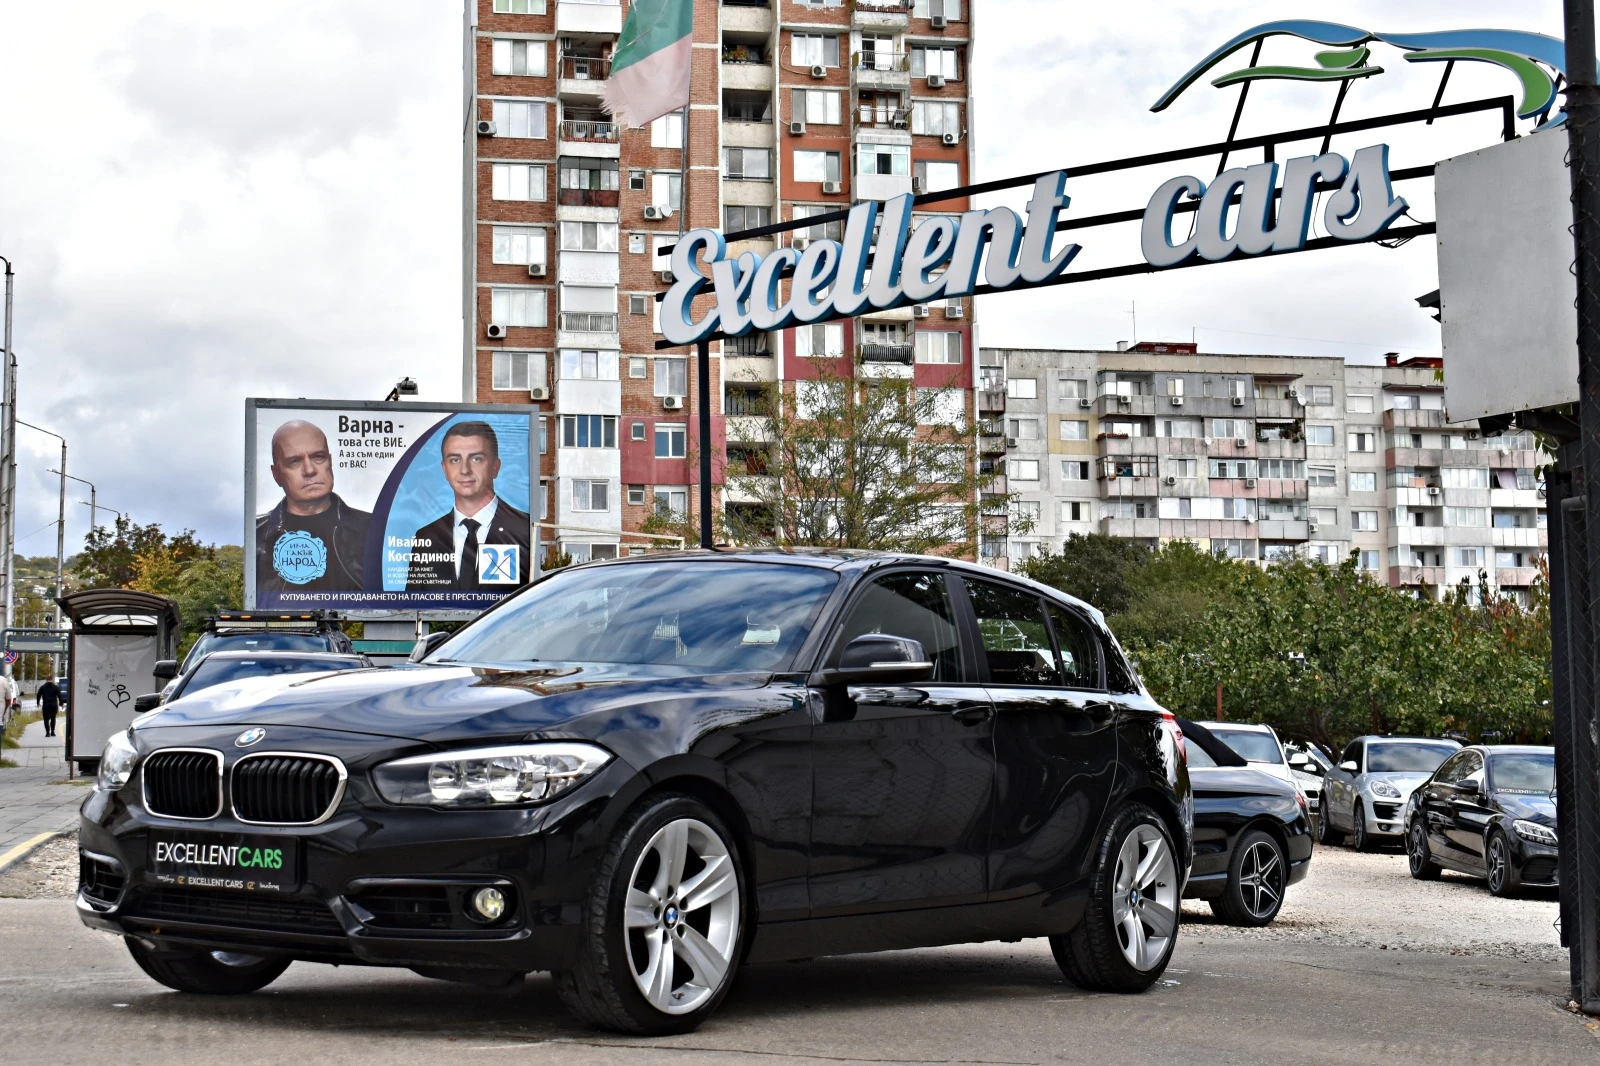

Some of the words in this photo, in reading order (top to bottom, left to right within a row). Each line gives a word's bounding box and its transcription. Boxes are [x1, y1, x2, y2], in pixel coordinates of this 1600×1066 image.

[660, 170, 1082, 345] Excellent
[1142, 143, 1410, 267] cars
[338, 415, 394, 438] Варна
[338, 438, 362, 447] това
[364, 439, 381, 447] сте
[383, 436, 407, 448] ВИЕ.
[339, 449, 345, 458] А
[374, 451, 395, 460] един
[350, 460, 367, 468] ВАС!
[388, 535, 432, 548] Ивайло
[388, 550, 456, 564] Костадинов
[281, 557, 318, 571] НАРОД
[481, 547, 517, 581] 21
[280, 593, 331, 601] КУПУВАНЕТО
[340, 593, 397, 602] ПРОДАВАНЕТО
[188, 876, 224, 887] EXCELLENT
[225, 879, 244, 888] CARS
